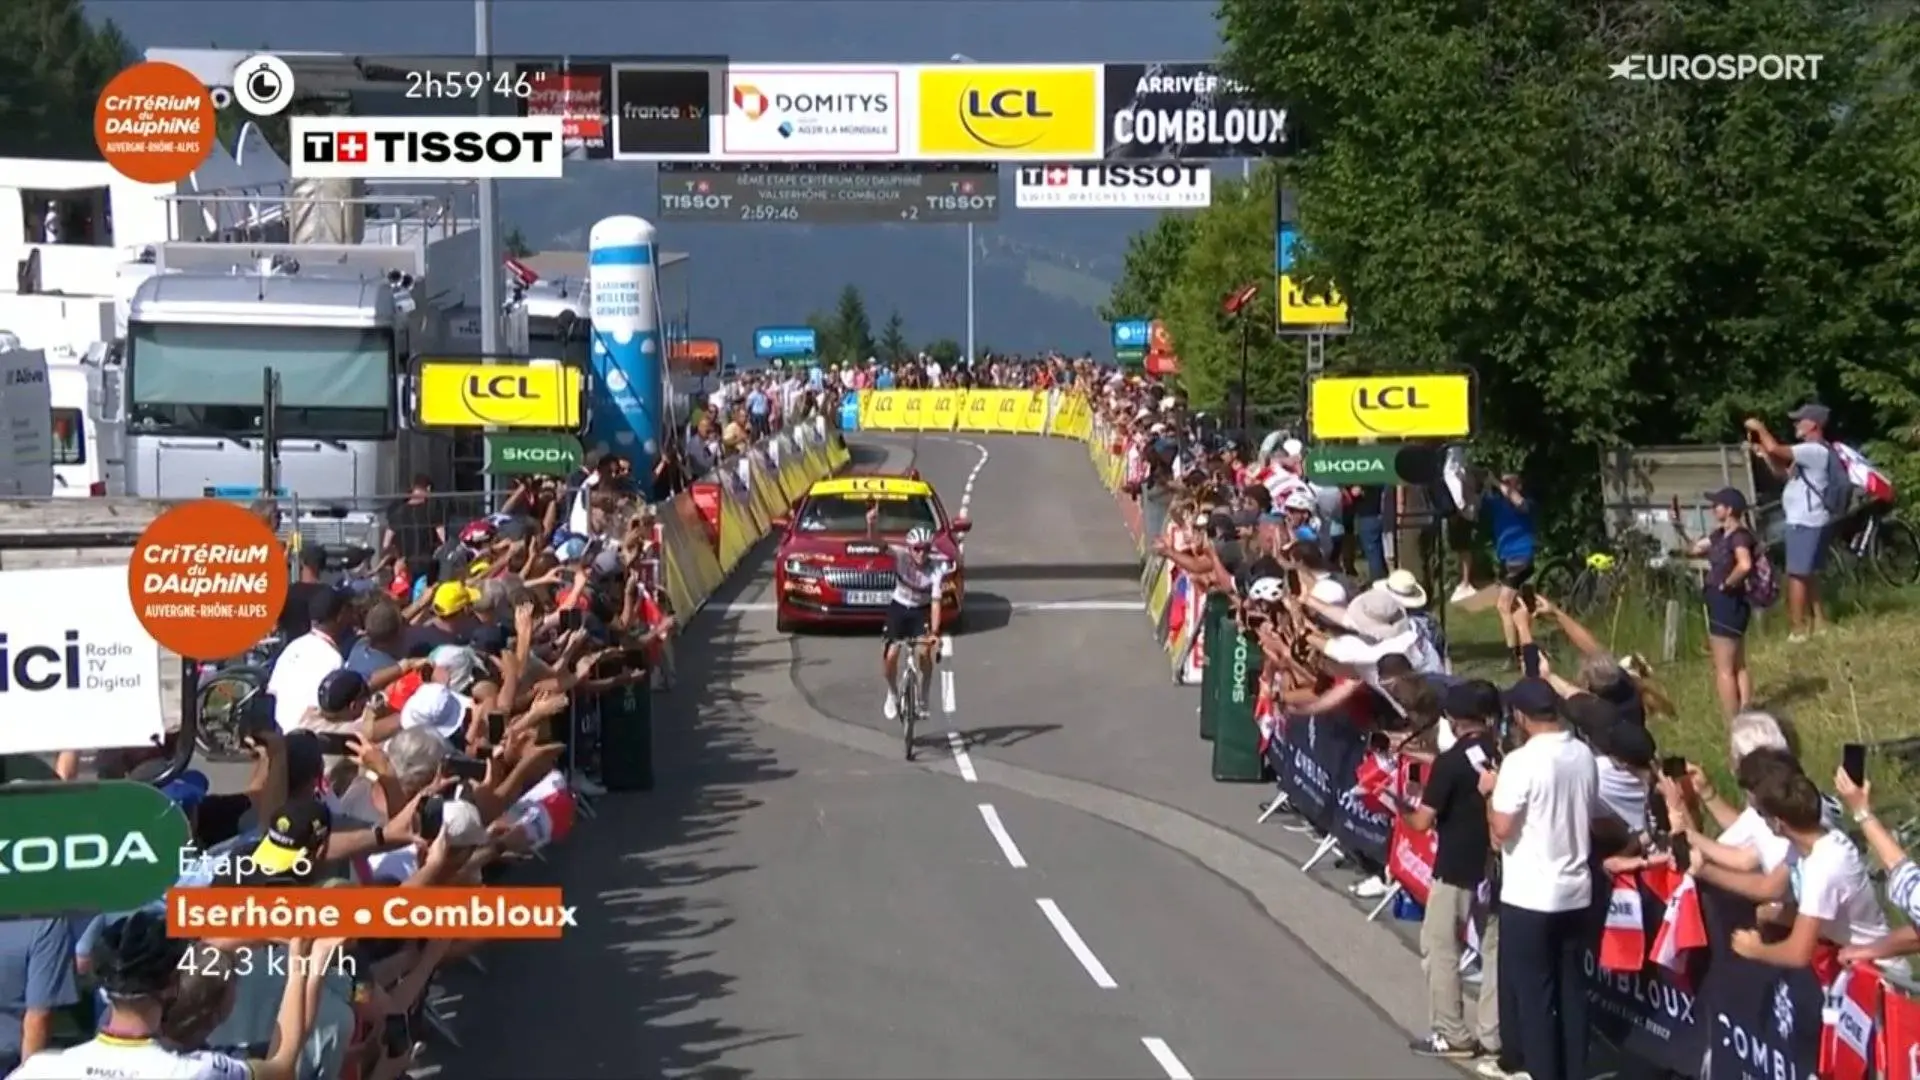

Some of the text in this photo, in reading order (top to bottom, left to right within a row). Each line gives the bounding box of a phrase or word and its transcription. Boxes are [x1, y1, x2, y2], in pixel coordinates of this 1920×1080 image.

[775, 94, 889, 113] DOMITYS
[969, 89, 1053, 118] LCL
[825, 124, 838, 134] LA
[840, 124, 888, 135] MONDIALE
[1114, 108, 1288, 144] COMBLOUX
[1073, 164, 1205, 187] TISSOT
[662, 194, 733, 210] TISSOT
[838, 189, 901, 201] COMBLOUX
[926, 195, 997, 210] TISSOT
[740, 205, 799, 220] 2:59:46
[470, 375, 541, 399] LCL
[1359, 386, 1430, 410] LCL
[502, 447, 574, 462] SKODA
[1313, 459, 1385, 474] SKODA
[85, 643, 132, 656] Radio
[0, 630, 80, 692] ici
[88, 660, 106, 672] TV
[86, 674, 141, 692] Digital
